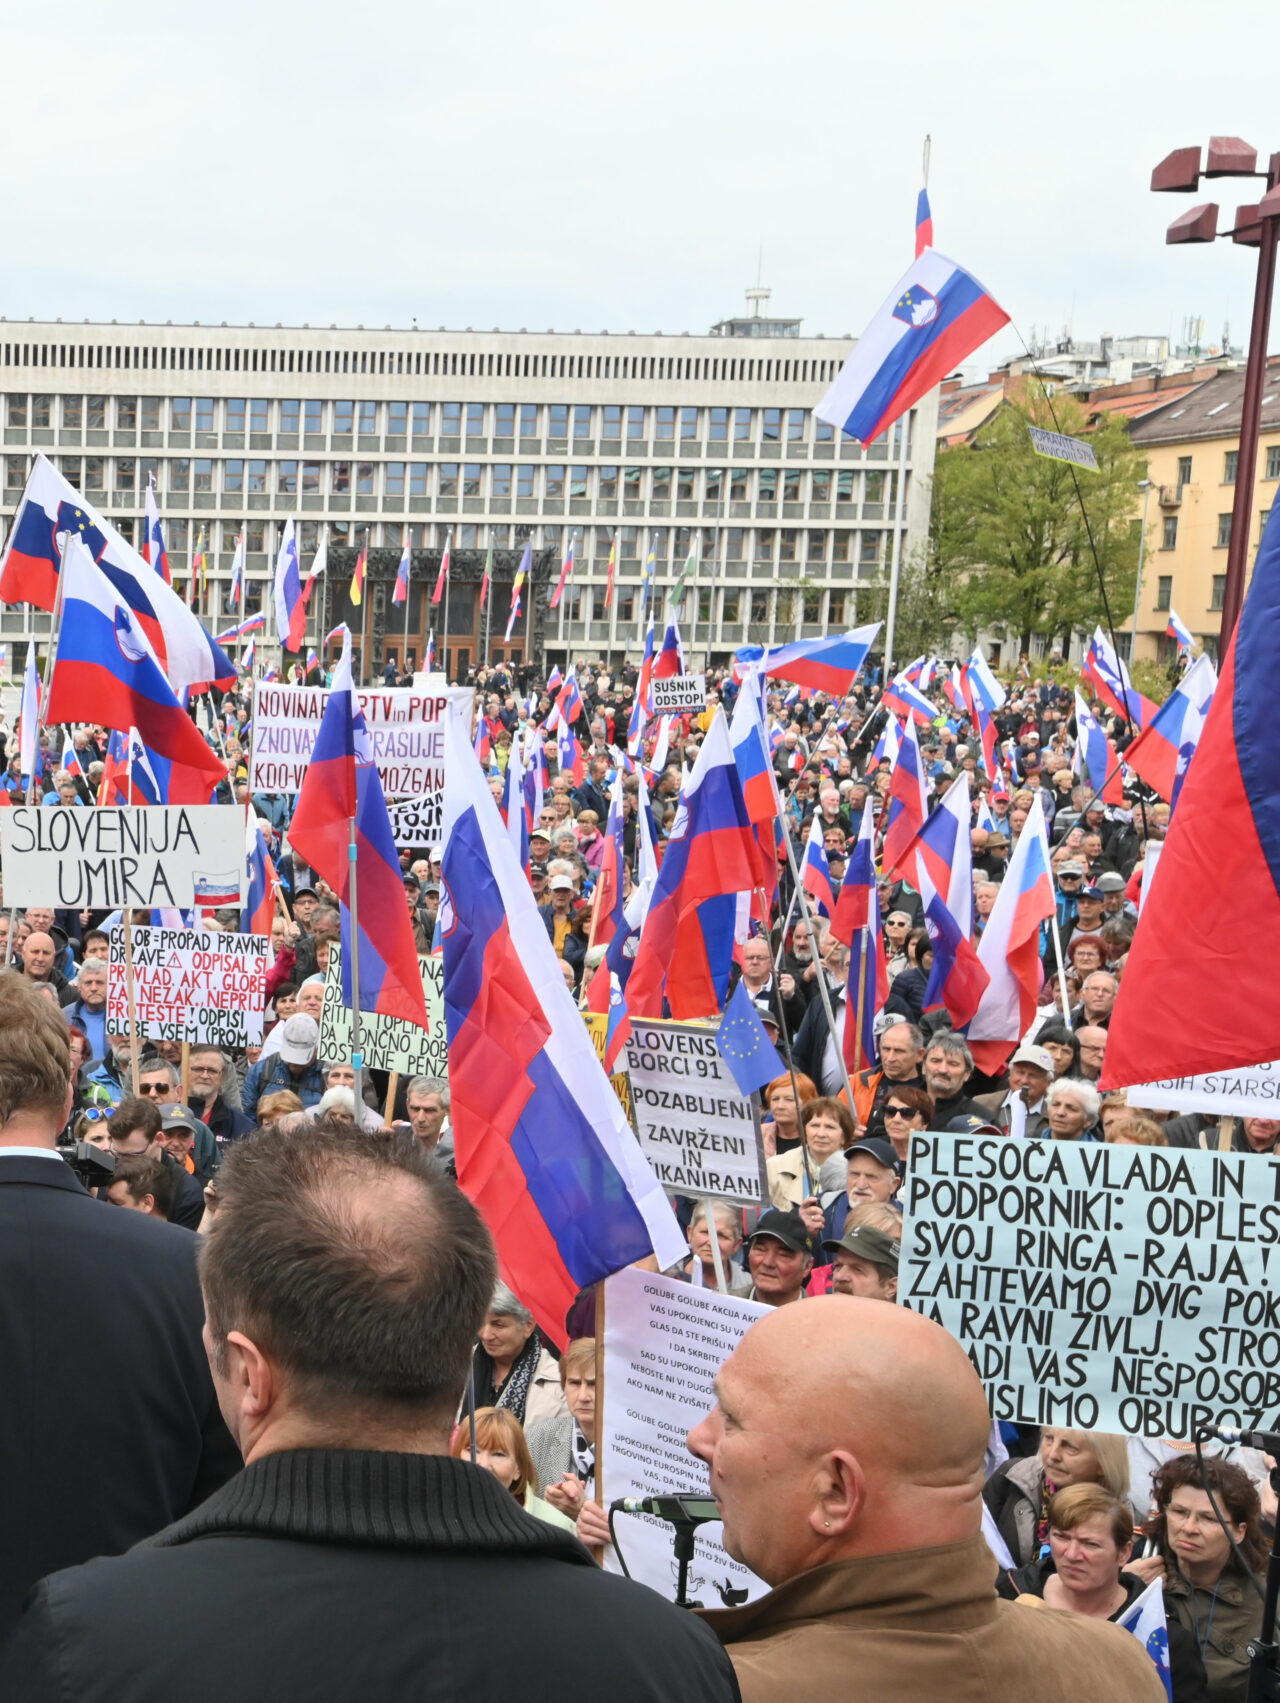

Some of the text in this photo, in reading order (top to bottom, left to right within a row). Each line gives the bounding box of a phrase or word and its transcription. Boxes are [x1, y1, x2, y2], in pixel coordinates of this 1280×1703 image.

[655, 679, 697, 692] SUŠNIK
[656, 694, 704, 706] ODSTOPI
[12, 808, 200, 855] SLOVENIJA
[58, 857, 176, 906] UMIRA
[219, 935, 268, 956] PRAVNE
[192, 952, 248, 974] ODPISAL
[108, 983, 128, 1000] ZA
[109, 964, 174, 987] PRVLAD.
[223, 974, 266, 994] GLOBE
[159, 1022, 198, 1043] VSEM
[199, 1008, 245, 1029] ODPIŠI
[321, 1022, 336, 1041] DA
[626, 1031, 722, 1058] SLOVENS
[628, 1052, 722, 1080] BORCI 91
[634, 1087, 752, 1120] POZABLJENI
[646, 1124, 746, 1156] ZAVRŽENI
[682, 1149, 703, 1168] IN
[910, 1136, 1068, 1186] PLESOČA
[1079, 1147, 1197, 1195] VLADA
[1212, 1158, 1246, 1199] IN
[648, 1157, 761, 1197] IKANIRANI
[909, 1177, 1280, 1244] PODPORNIKI: ODPLES
[913, 1220, 993, 1262] SVOJ
[644, 1285, 676, 1300] GOLUBE
[677, 1295, 710, 1311] GOLUBE
[712, 1304, 740, 1319] AKCIJA
[908, 1259, 1112, 1313] ZAHTEVAMO
[1133, 1280, 1202, 1320] DVIG
[650, 1304, 666, 1315] VAS
[668, 1308, 719, 1330] UPOKOJENCI
[720, 1322, 732, 1334] SU
[960, 1302, 1054, 1346] RAVNI
[1068, 1310, 1170, 1358] ŽIVLJ.
[650, 1320, 670, 1332] GLAS
[672, 1326, 684, 1337] DA
[685, 1330, 700, 1342] STE
[702, 1335, 726, 1350] PRIŠLI
[640, 1350, 717, 1379] SAD SU UPOKOJEN
[674, 1344, 686, 1354] DA
[688, 1348, 720, 1364] SKRBITE
[1027, 1347, 1088, 1388] VAS
[630, 1362, 712, 1395] NEBOSTE NI VI DUGO
[626, 1378, 711, 1411] AKO NAM NE ZVIŠATE
[983, 1383, 1099, 1429] ISLIMO
[626, 1408, 656, 1426] GOLUBE
[612, 1444, 652, 1465] TRGOVINO
[654, 1460, 694, 1480] EUROSPIN
[614, 1434, 663, 1456] UPOKOJENCI
[664, 1451, 700, 1469] MORAJO
[631, 1480, 643, 1490] PRI
[663, 1476, 674, 1486] DA
[676, 1481, 688, 1490] NE
[714, 1552, 727, 1567] ŽIV
